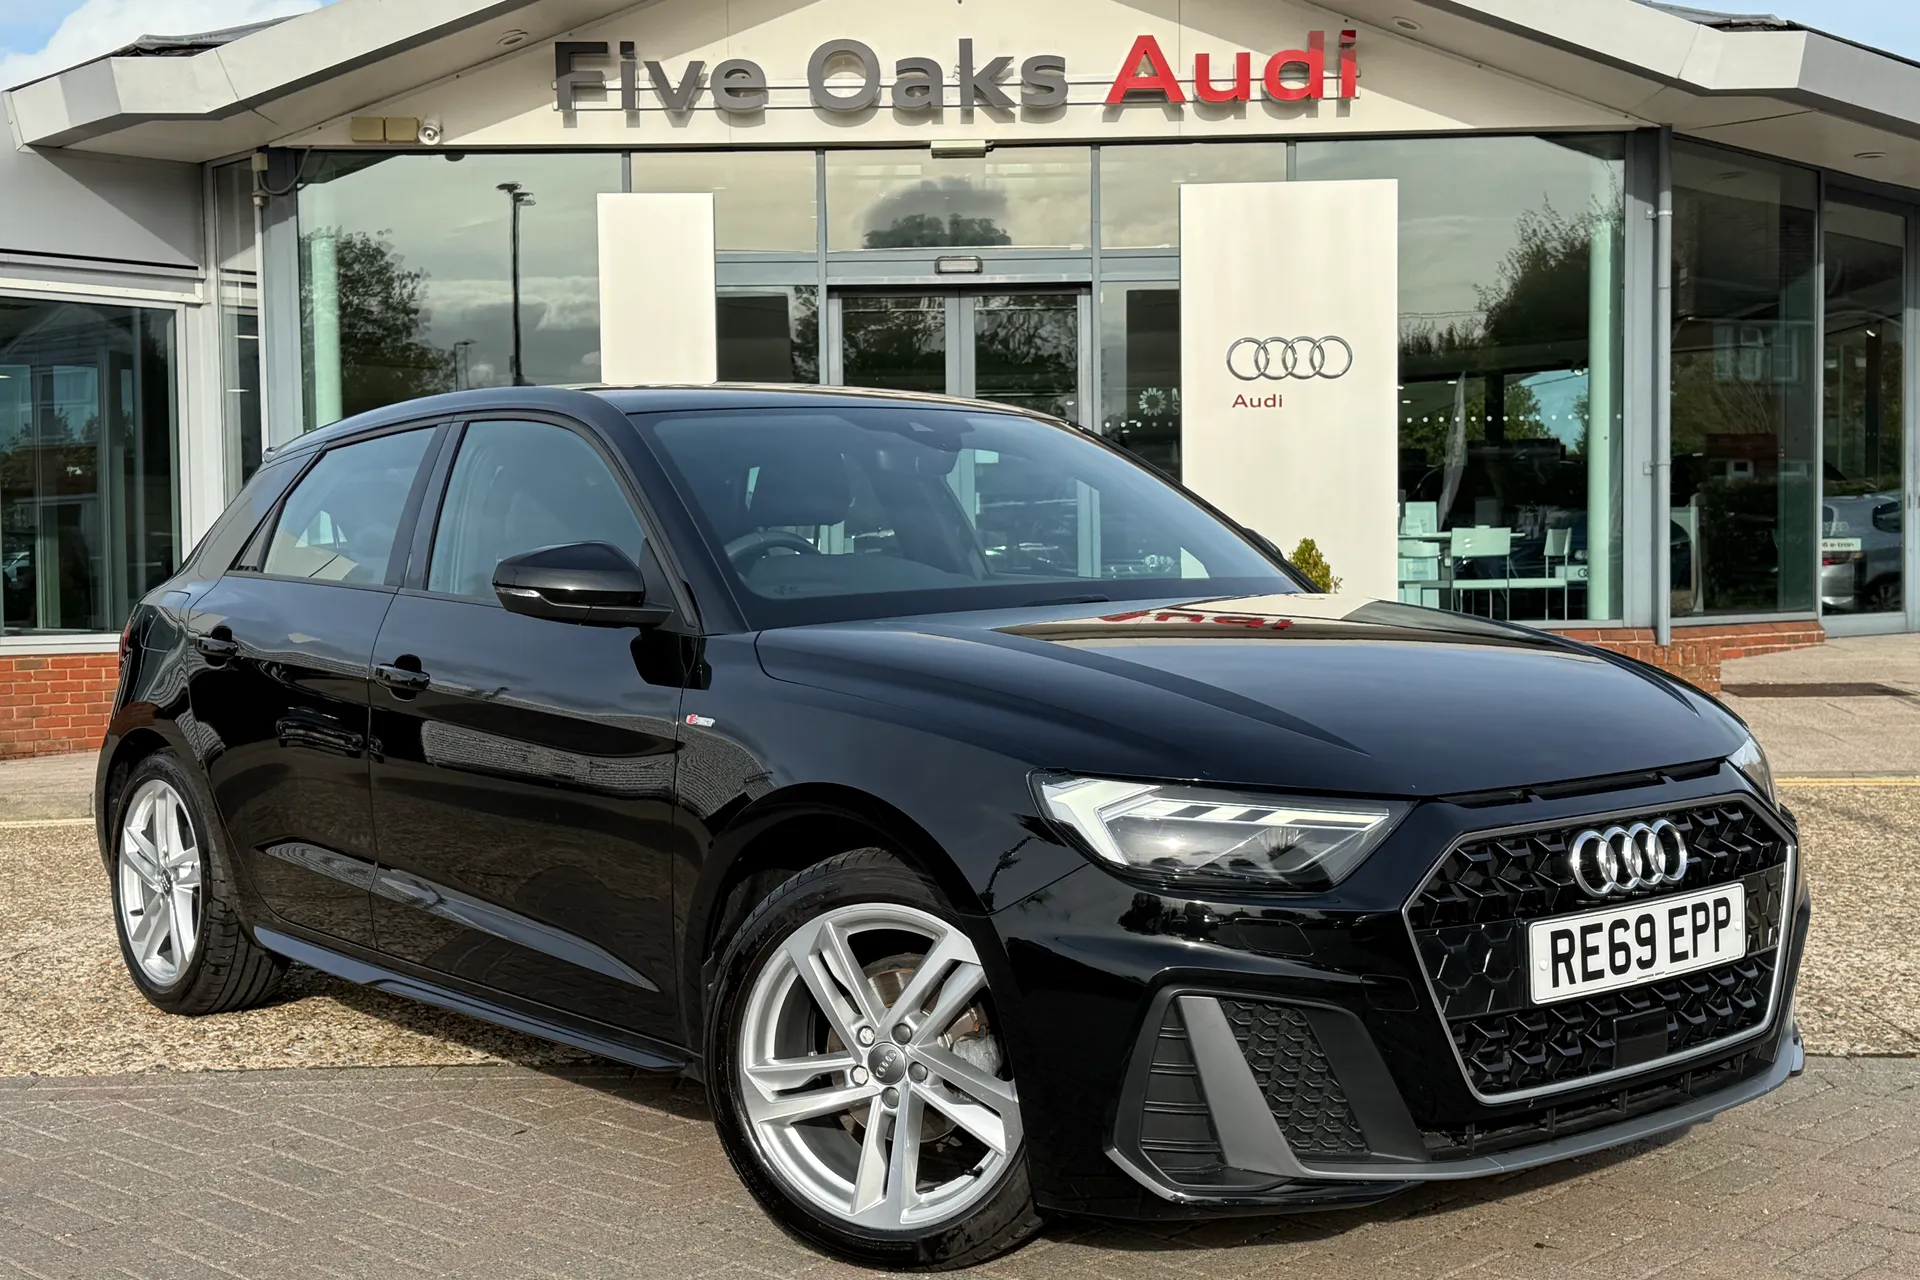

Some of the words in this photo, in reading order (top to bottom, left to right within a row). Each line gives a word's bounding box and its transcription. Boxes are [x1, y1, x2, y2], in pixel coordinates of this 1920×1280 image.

[555, 41, 769, 113] Five
[807, 38, 1069, 112] Oaks
[1105, 30, 1357, 104] Audi
[1232, 394, 1283, 408] Audi
[1550, 913, 1657, 989] RE69
[1668, 897, 1731, 963] EPP
